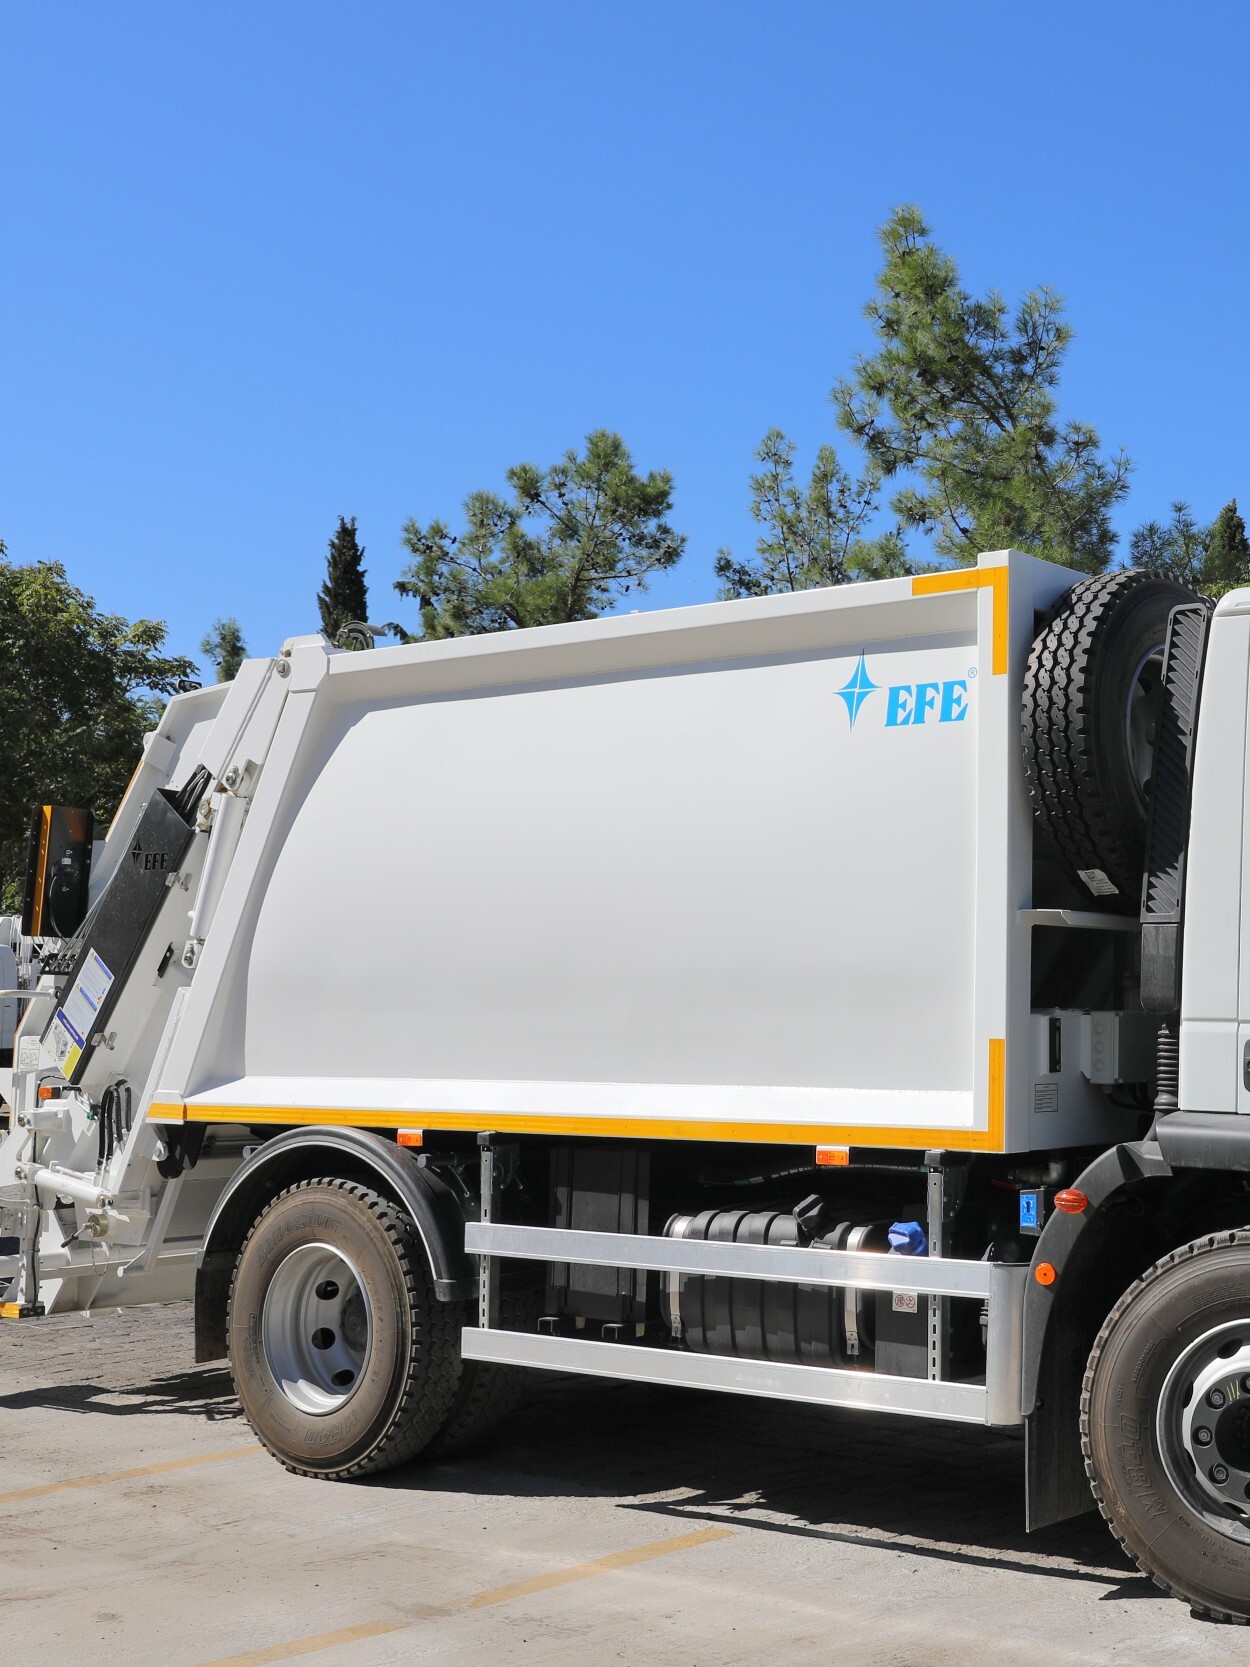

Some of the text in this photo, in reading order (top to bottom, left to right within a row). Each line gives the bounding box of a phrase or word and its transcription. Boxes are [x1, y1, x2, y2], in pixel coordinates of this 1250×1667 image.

[885, 680, 969, 727] EFE
[144, 852, 168, 870] EFE
[1120, 1412, 1169, 1520] M840
